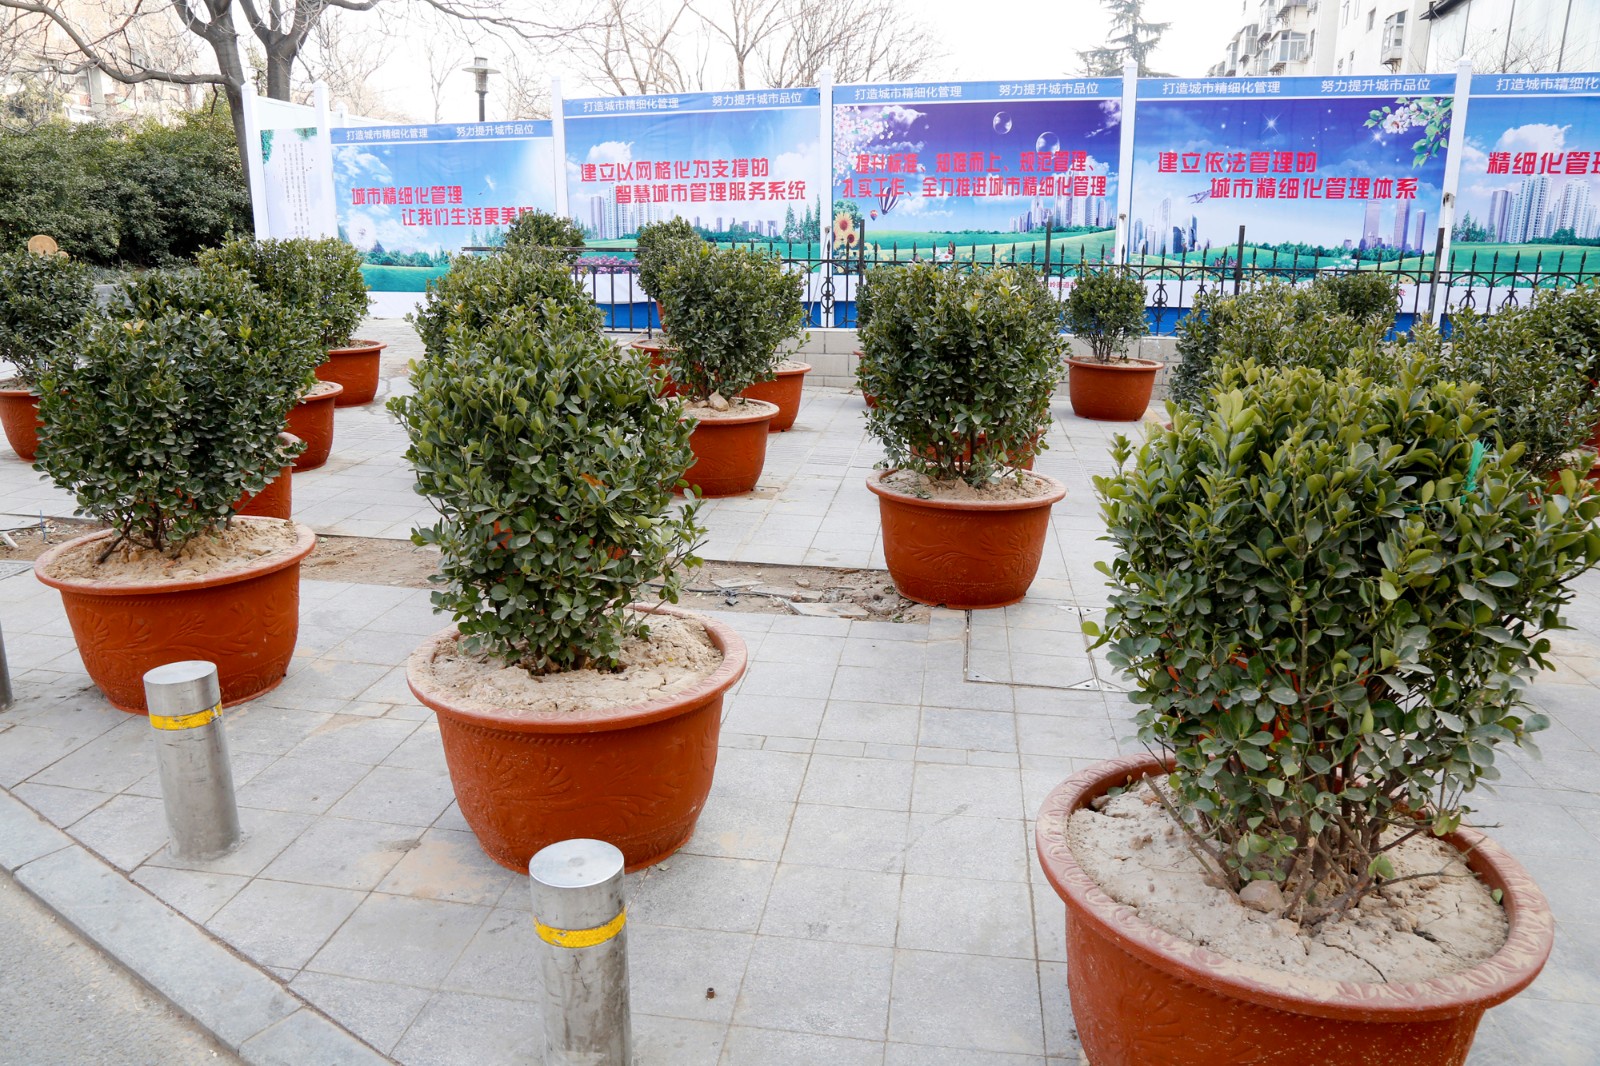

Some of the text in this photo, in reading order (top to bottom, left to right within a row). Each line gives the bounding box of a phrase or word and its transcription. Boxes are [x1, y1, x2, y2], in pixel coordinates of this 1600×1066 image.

[855, 82, 1099, 100] 打造城市精细化管理 努力提升城市品位
[1163, 78, 1431, 95] 打造城市精细化管理 努力提升城市品位
[1496, 76, 1599, 91] 打造城市精细化
[583, 92, 803, 113] 打造城市精细化管理 努力提升城市品位
[346, 124, 534, 141] 打造城市精细化管理 努力提升城市品位
[580, 157, 769, 182] 建立以网格化为支撑的
[1157, 151, 1318, 173] 建立依法管理的
[351, 185, 463, 205] 城市精细化管理
[615, 180, 806, 204] 智慧城市管理服务系统
[842, 175, 1107, 198] 扎实工作、全力推进城市精细化管理
[1209, 177, 1419, 200] 城市精细化管理体系
